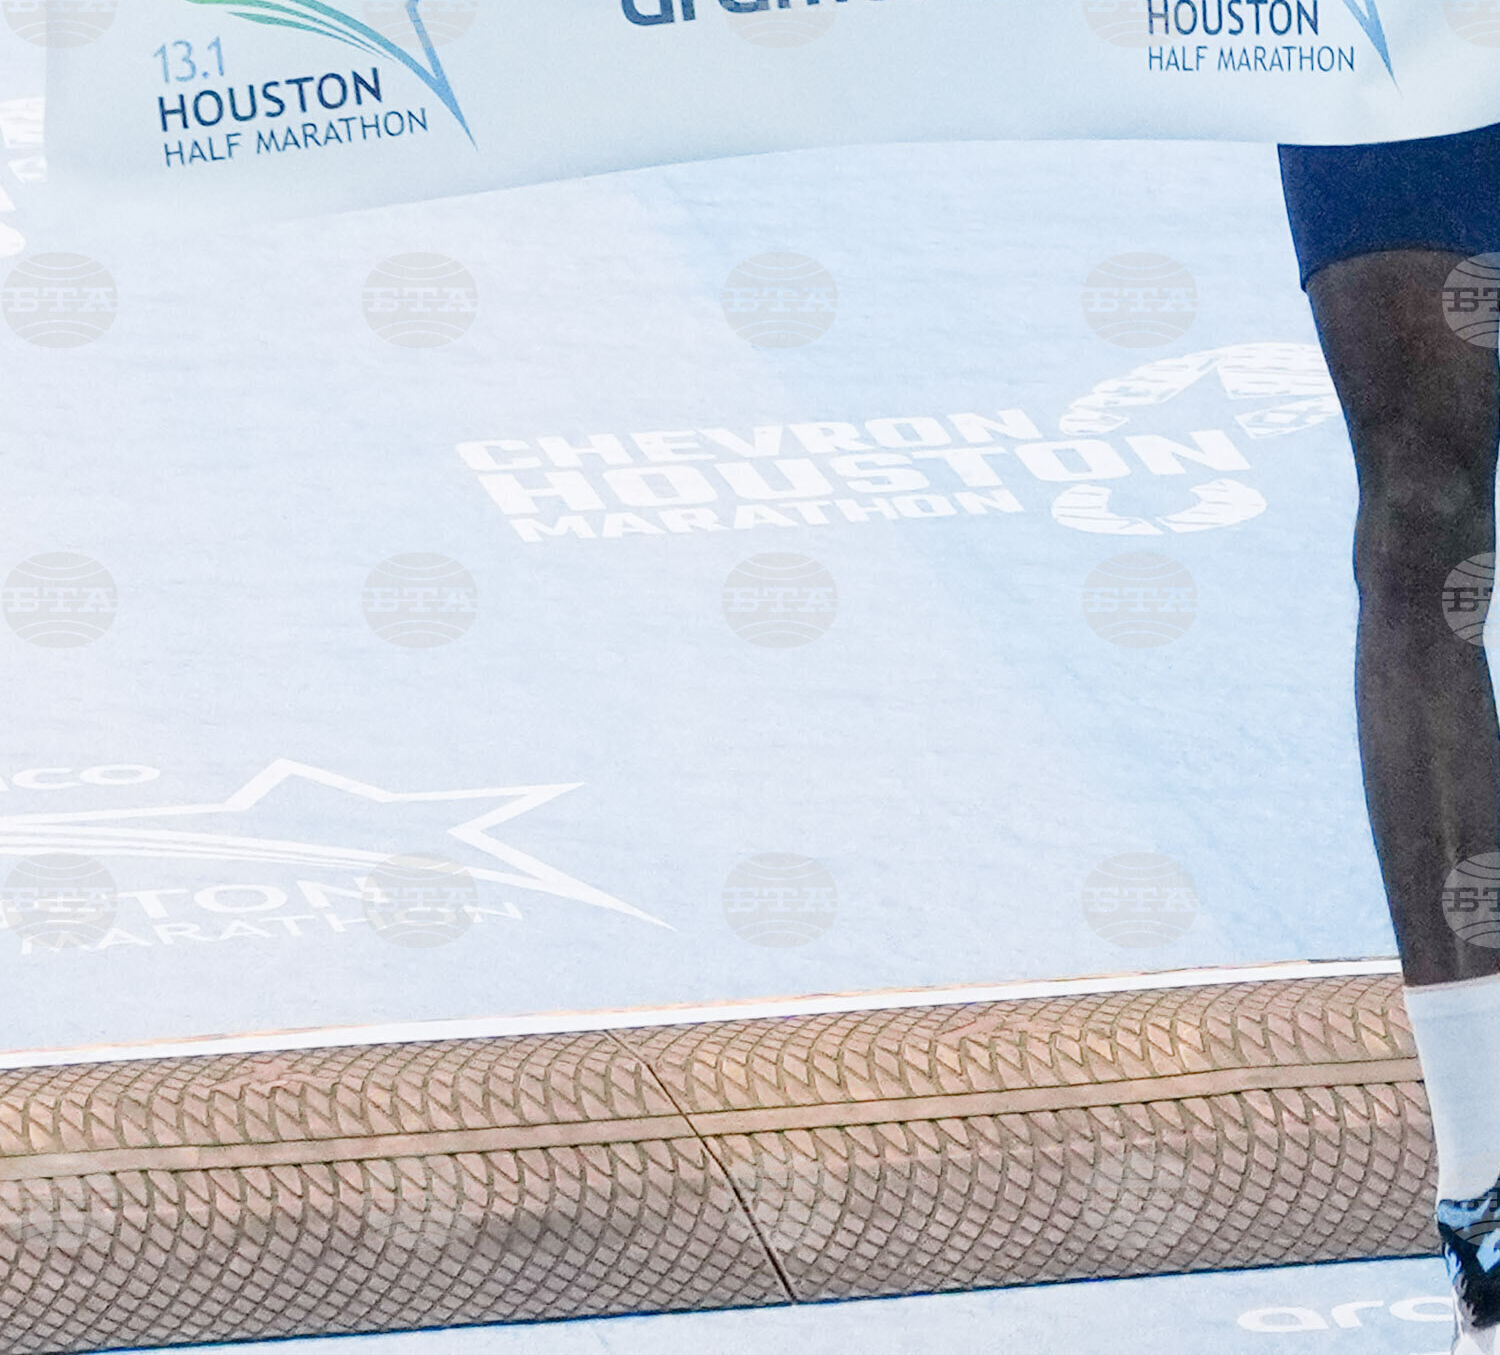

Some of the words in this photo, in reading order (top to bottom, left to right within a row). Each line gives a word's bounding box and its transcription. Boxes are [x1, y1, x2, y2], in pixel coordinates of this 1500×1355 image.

[152, 36, 225, 84] 13.1
[1148, 46, 1207, 72] HALF
[1217, 46, 1355, 72] MARATHON
[158, 67, 383, 133] HOUSTON
[164, 132, 243, 168] HALF
[256, 108, 429, 155] MARATHON
[460, 409, 1044, 472] CHEVRON
[477, 429, 1250, 514] HOUSTON
[508, 489, 1025, 542] MARATHON
